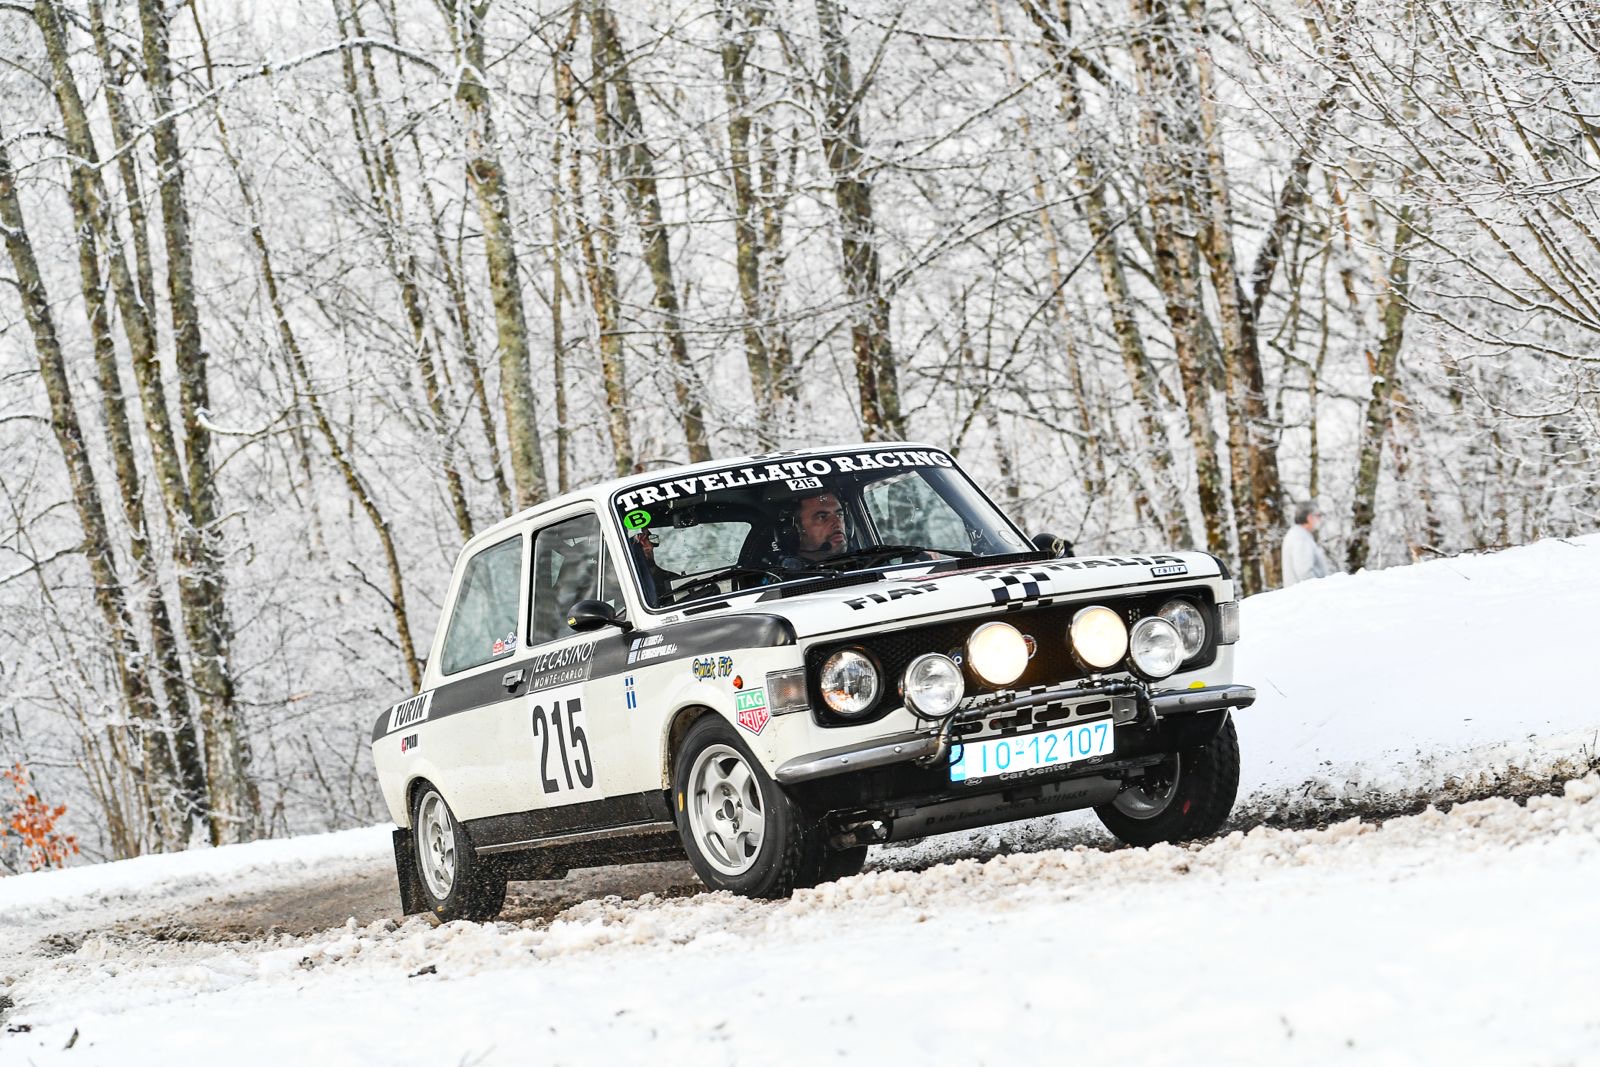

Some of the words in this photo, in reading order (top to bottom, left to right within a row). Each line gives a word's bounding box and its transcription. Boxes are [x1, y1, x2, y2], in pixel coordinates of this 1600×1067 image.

[617, 459, 832, 511] TRIVELLATO
[831, 451, 953, 473] RACING
[791, 477, 818, 490] 215
[628, 512, 647, 528] B
[842, 583, 939, 610] FIAT
[1042, 555, 1185, 572] ITALIA
[535, 653, 548, 673] LE
[548, 641, 593, 670] CASINO
[692, 656, 716, 682] Quick
[718, 656, 734, 677] Fit
[394, 695, 427, 727] TURIN
[738, 693, 763, 708] TAG
[740, 709, 768, 731] HEUER
[533, 698, 593, 793] 215
[1000, 770, 1025, 781] Car
[1026, 762, 1073, 778] Center
